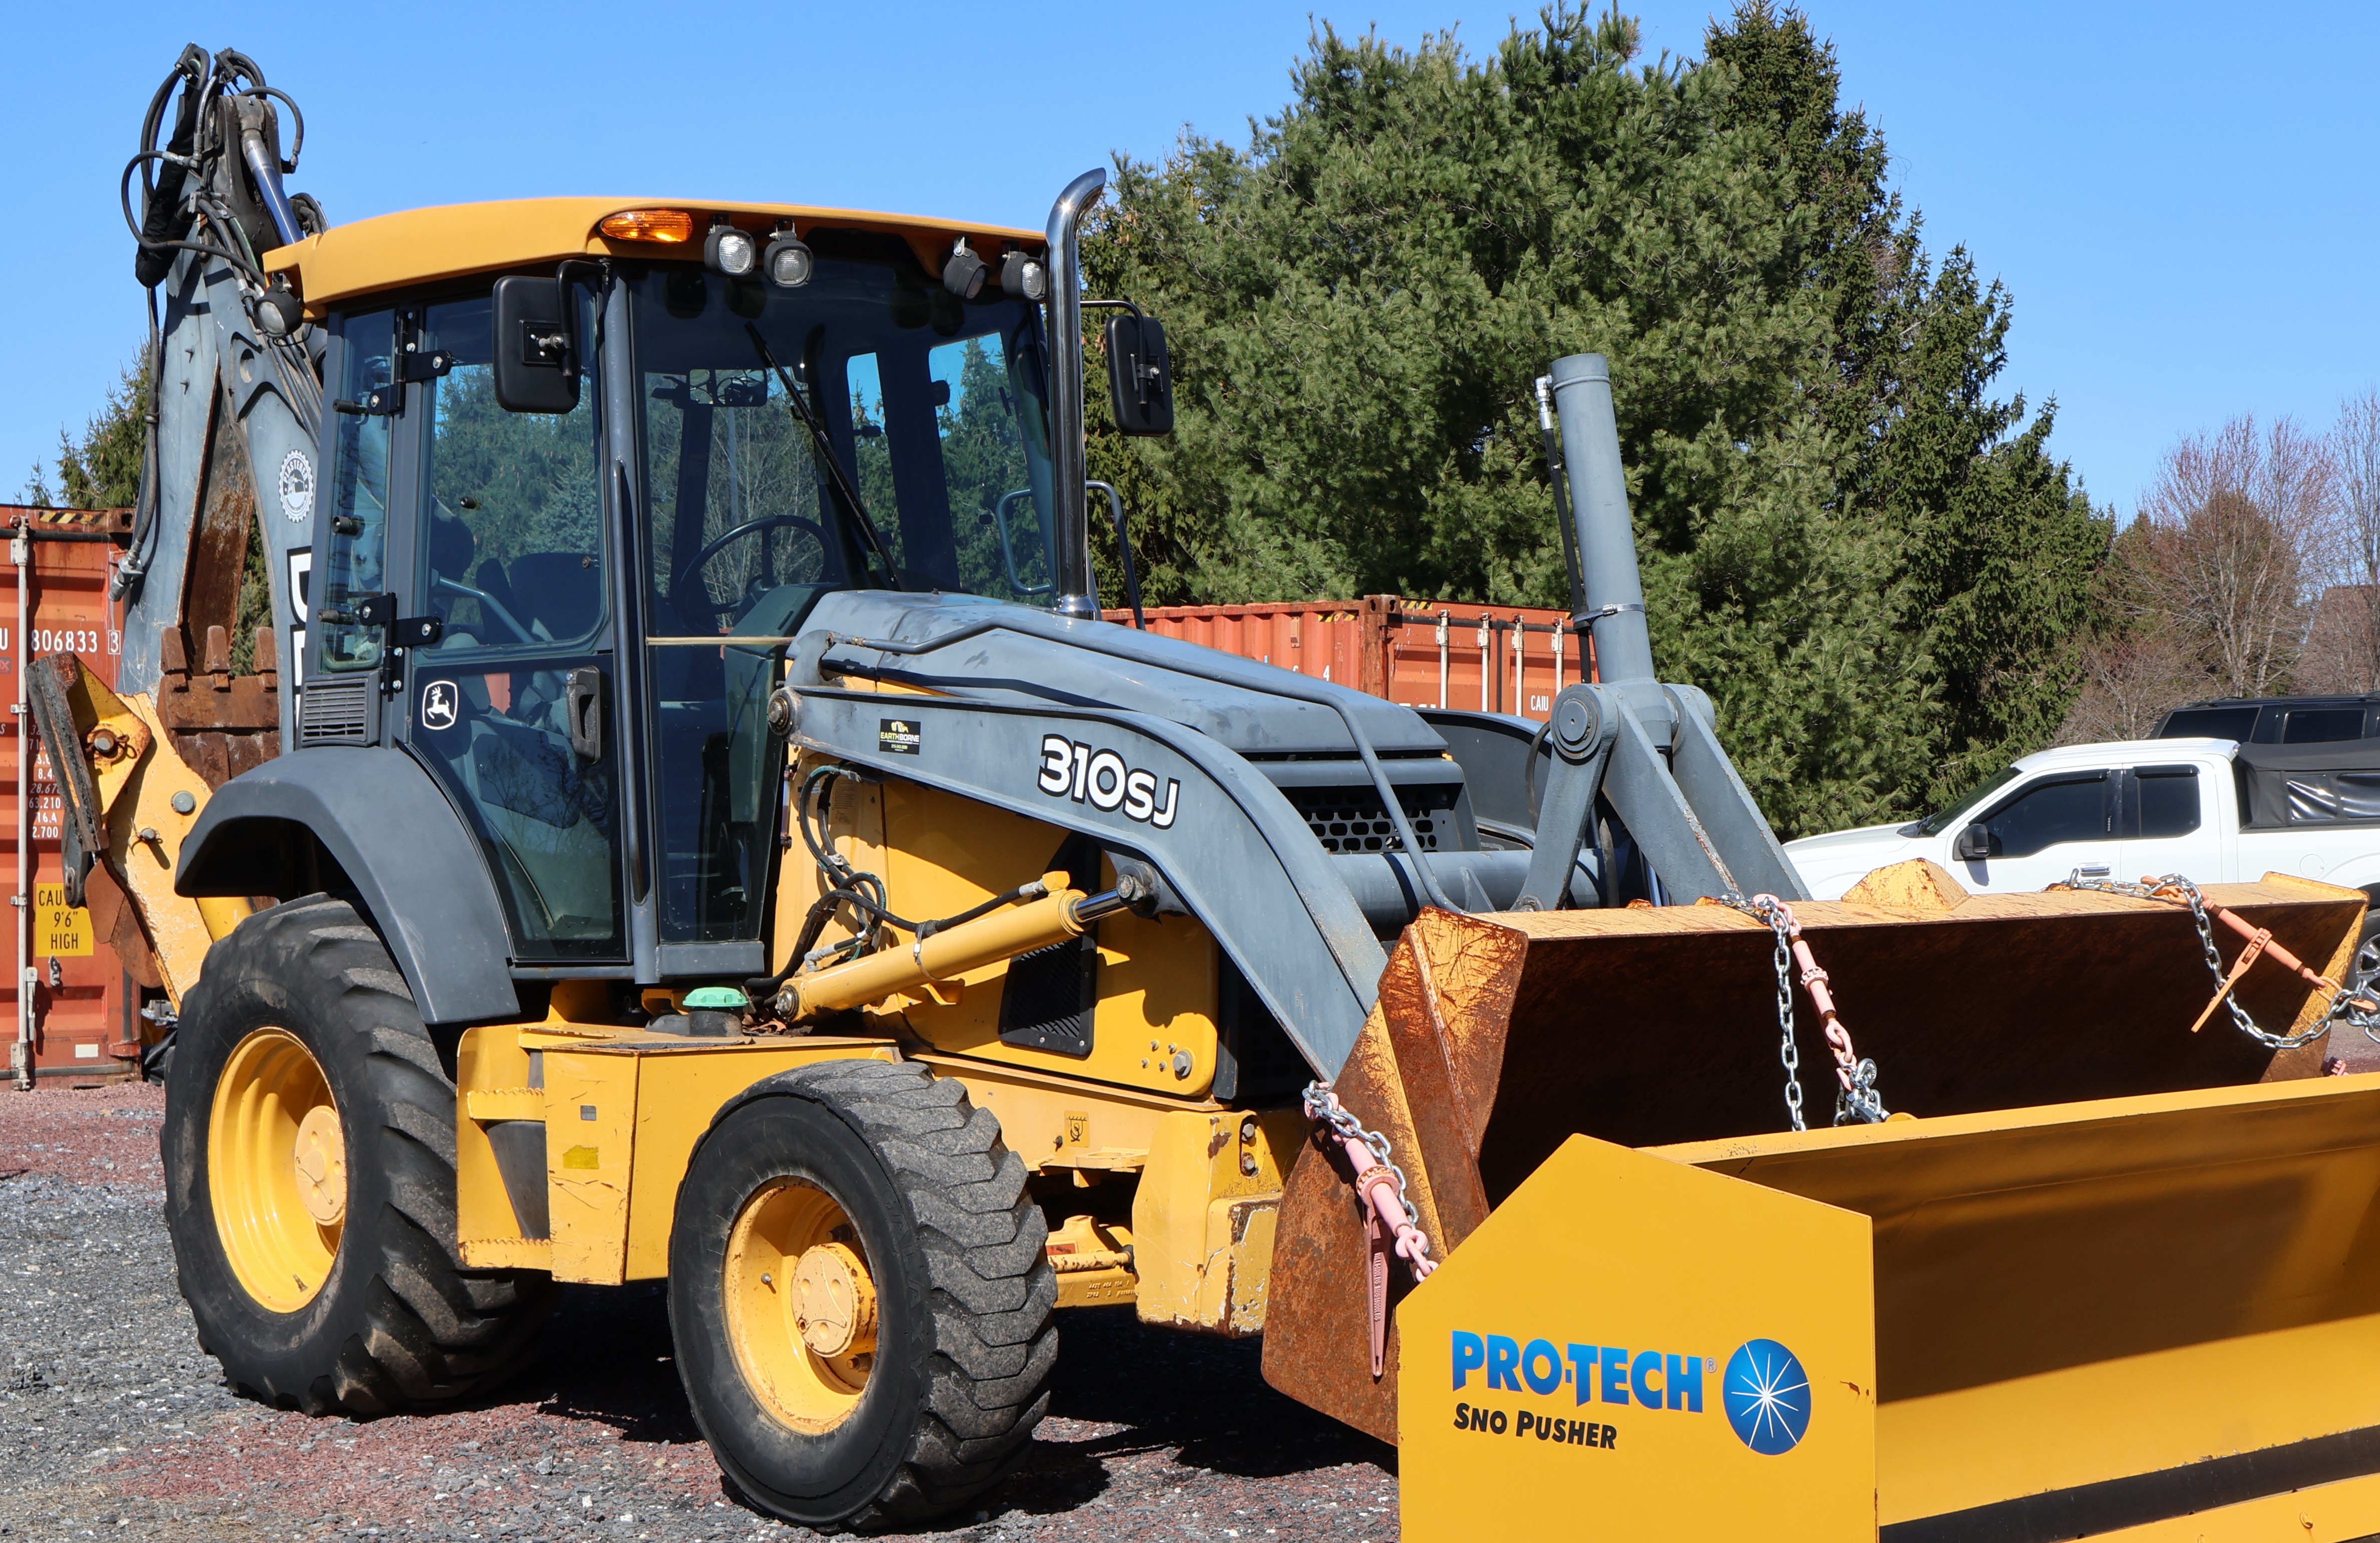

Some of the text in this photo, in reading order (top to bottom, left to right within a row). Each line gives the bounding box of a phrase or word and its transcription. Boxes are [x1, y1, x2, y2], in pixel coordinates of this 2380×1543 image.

[31, 629, 98, 653] 806833
[1531, 695, 1549, 711] CAIU
[29, 739, 46, 750] 71.
[880, 732, 920, 742] EARTHBORNE
[1038, 734, 1180, 829] 310SJ
[29, 797, 61, 809] 63.210
[32, 826, 58, 838] 2.700
[51, 933, 78, 950] HIGH
[1516, 1410, 1618, 1450] PUSHER
